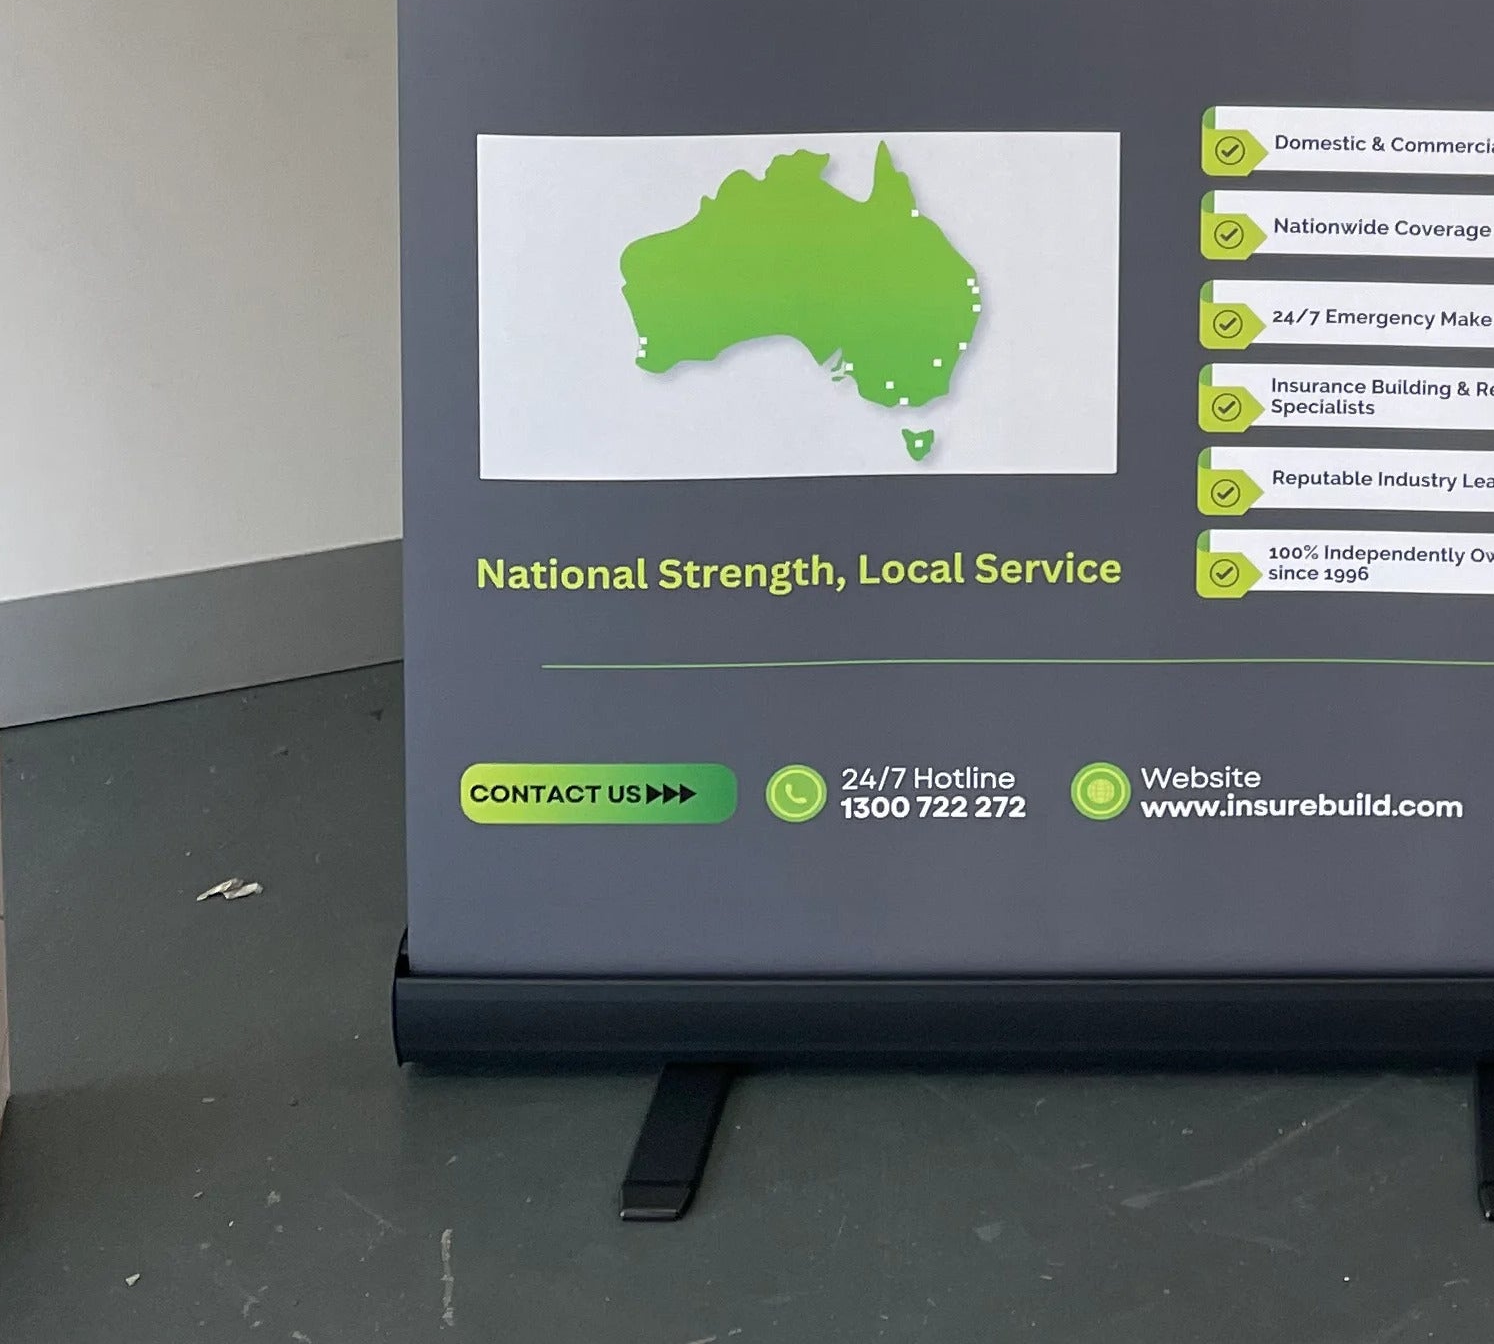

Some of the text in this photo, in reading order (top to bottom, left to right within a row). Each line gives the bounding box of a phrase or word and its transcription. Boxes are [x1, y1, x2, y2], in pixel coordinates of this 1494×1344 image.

[1276, 135, 1366, 150] Domestic
[1372, 137, 1385, 151] &
[1275, 218, 1491, 241] Nationwide Coverage
[1273, 309, 1320, 325] 24/7
[1327, 309, 1435, 329] Emergency
[1442, 312, 1492, 326] Make
[1273, 378, 1366, 393] Insurance
[1372, 380, 1450, 399] Building
[1458, 382, 1470, 396] &
[1272, 399, 1374, 417] Specialists
[1273, 470, 1372, 488] Reputable
[1379, 472, 1457, 492] Industry
[1270, 545, 1318, 559] 100%
[1325, 545, 1465, 566] Independently
[477, 551, 1122, 596] National Strength, Local Service
[1269, 565, 1368, 583] since 1996
[842, 766, 1015, 791] 24/7 Hotline
[1141, 766, 1261, 789] Website
[471, 785, 641, 803] CONTACT US
[841, 796, 1025, 818] 1300 722 272
[1141, 793, 1462, 817] www.insurebuild.com
